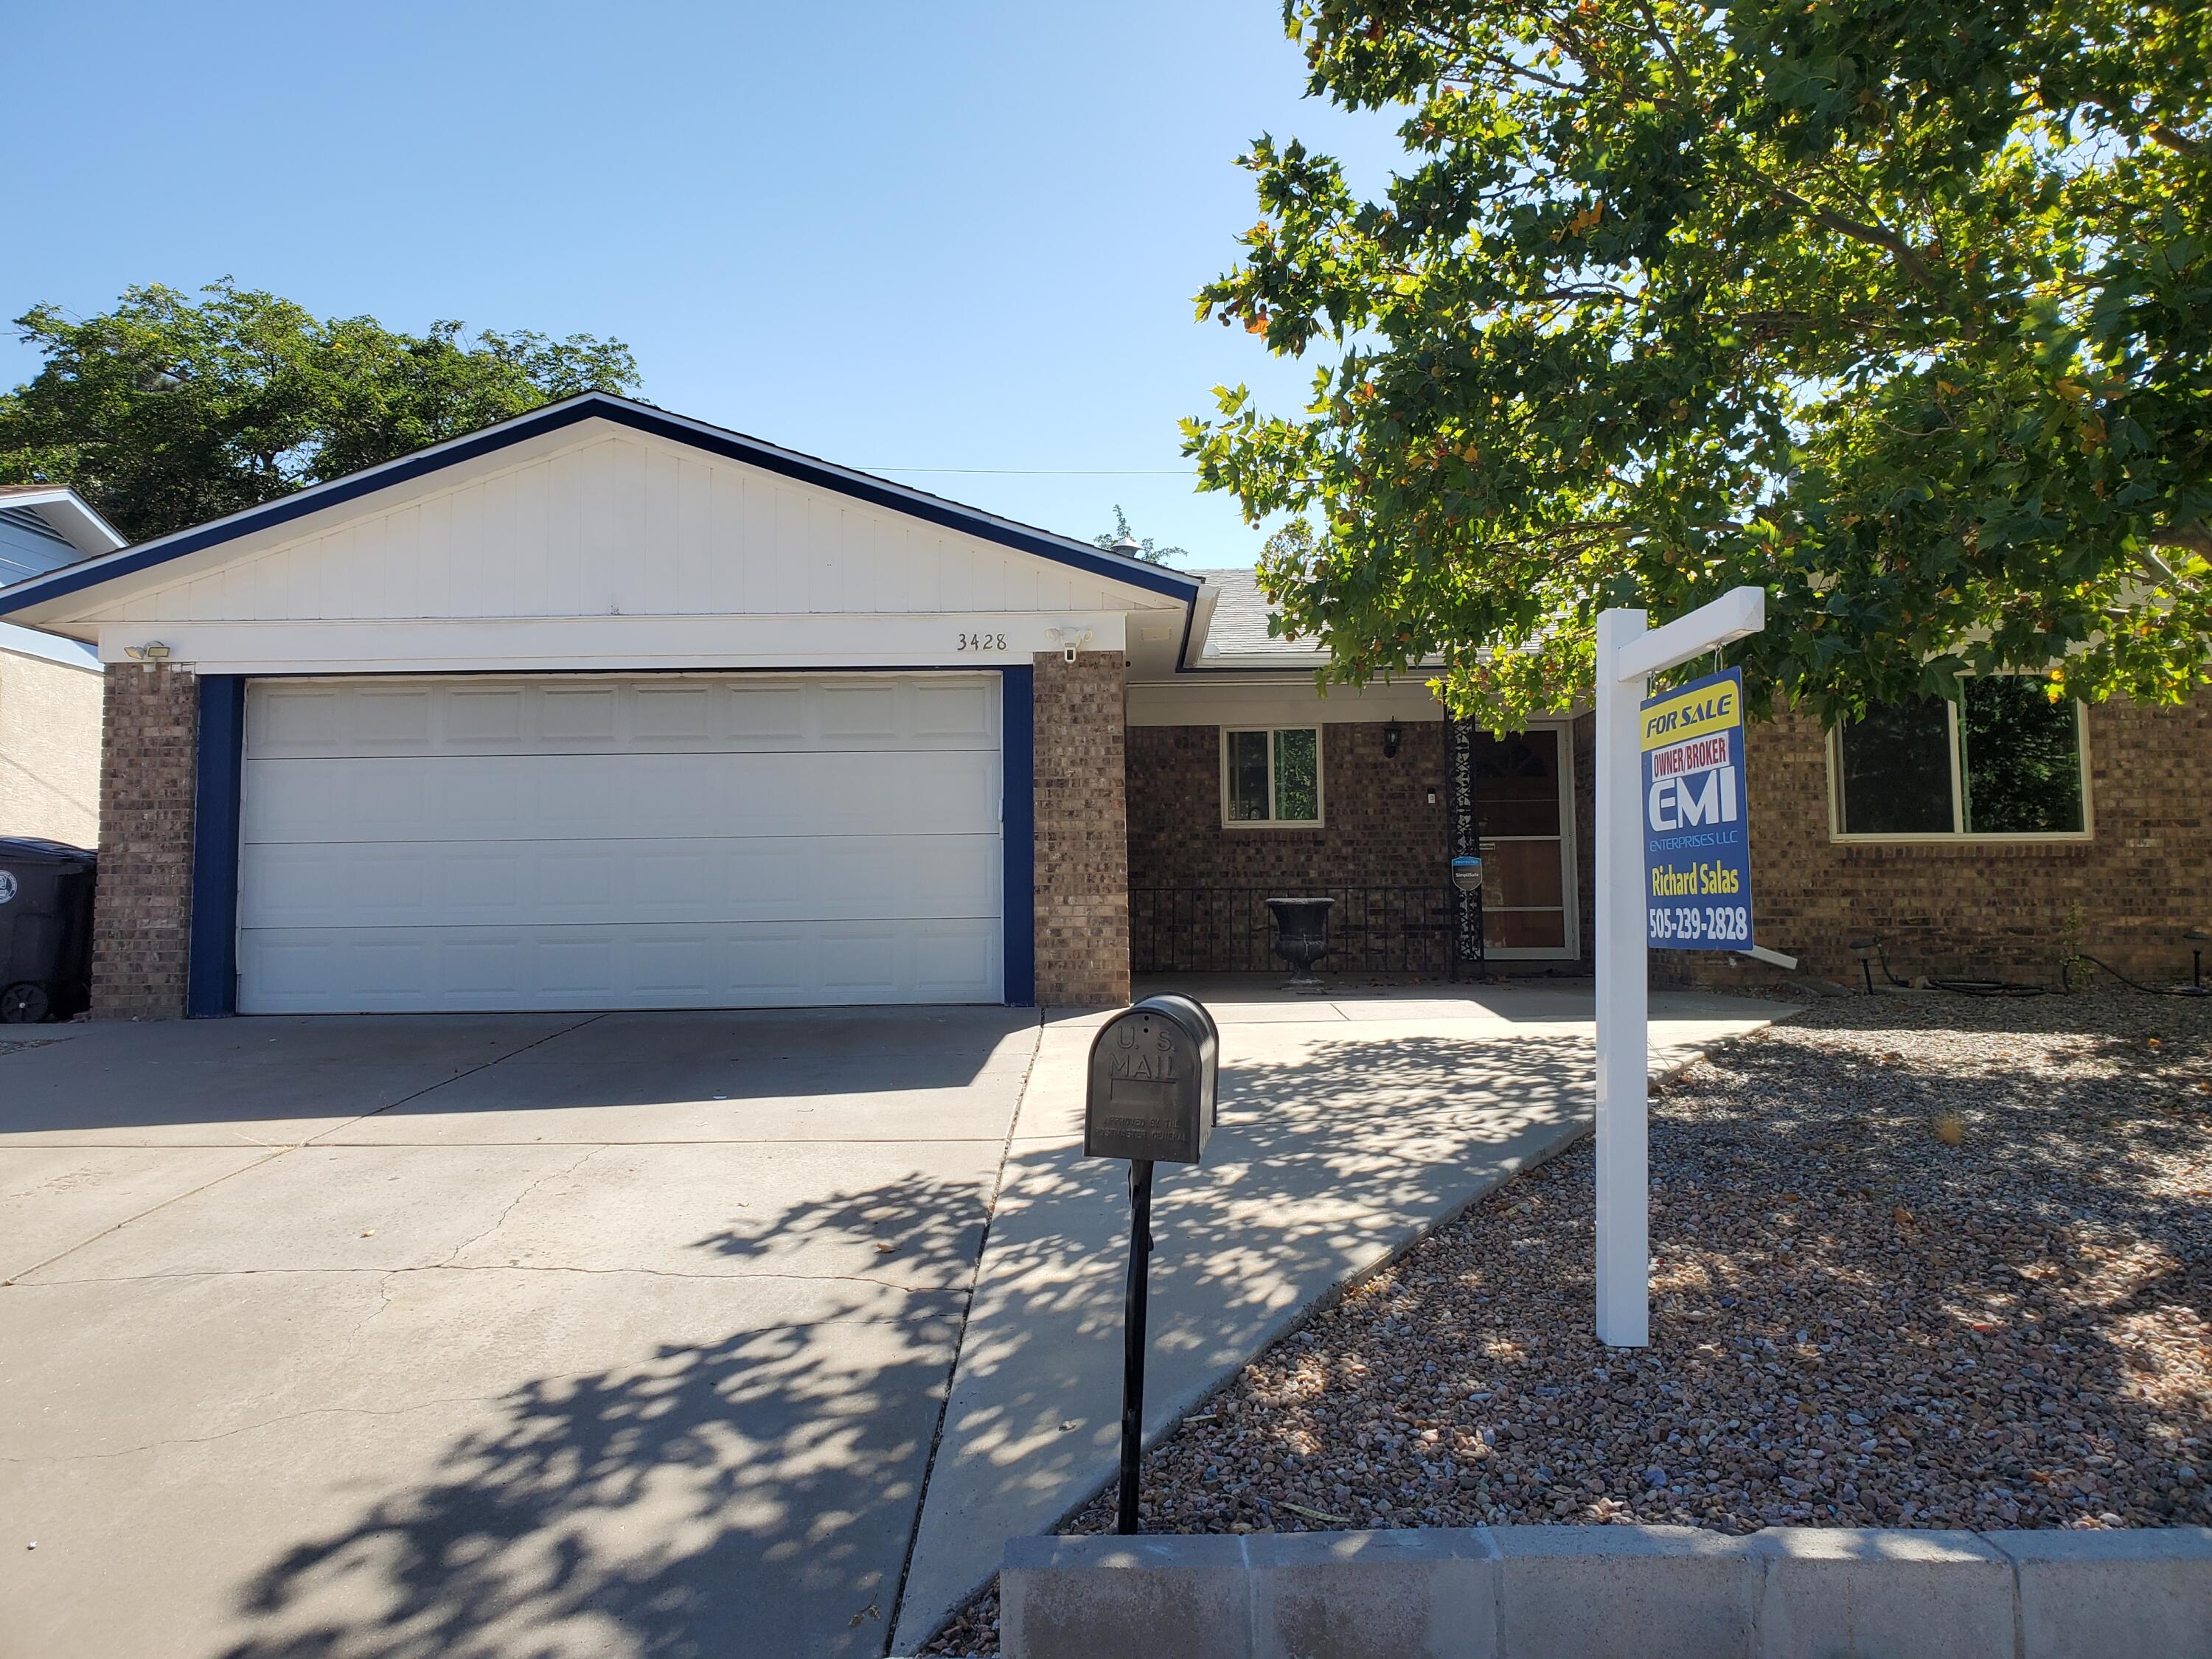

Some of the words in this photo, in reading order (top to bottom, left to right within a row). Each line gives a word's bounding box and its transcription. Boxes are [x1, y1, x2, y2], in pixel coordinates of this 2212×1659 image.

[957, 633, 1007, 651] 3428
[1646, 711, 1677, 739] FOR
[1680, 694, 1733, 728] SALE
[1654, 737, 1727, 778] OWNER/BROKER
[1649, 765, 1737, 832] EMI
[1649, 832, 1714, 852] ENTERPRISES
[1716, 830, 1738, 844] LLC
[1652, 861, 1697, 897] Richard
[1700, 860, 1739, 894] Salas
[1649, 906, 1747, 940] 505-239-2828
[1109, 1053, 1181, 1080] MAIL
